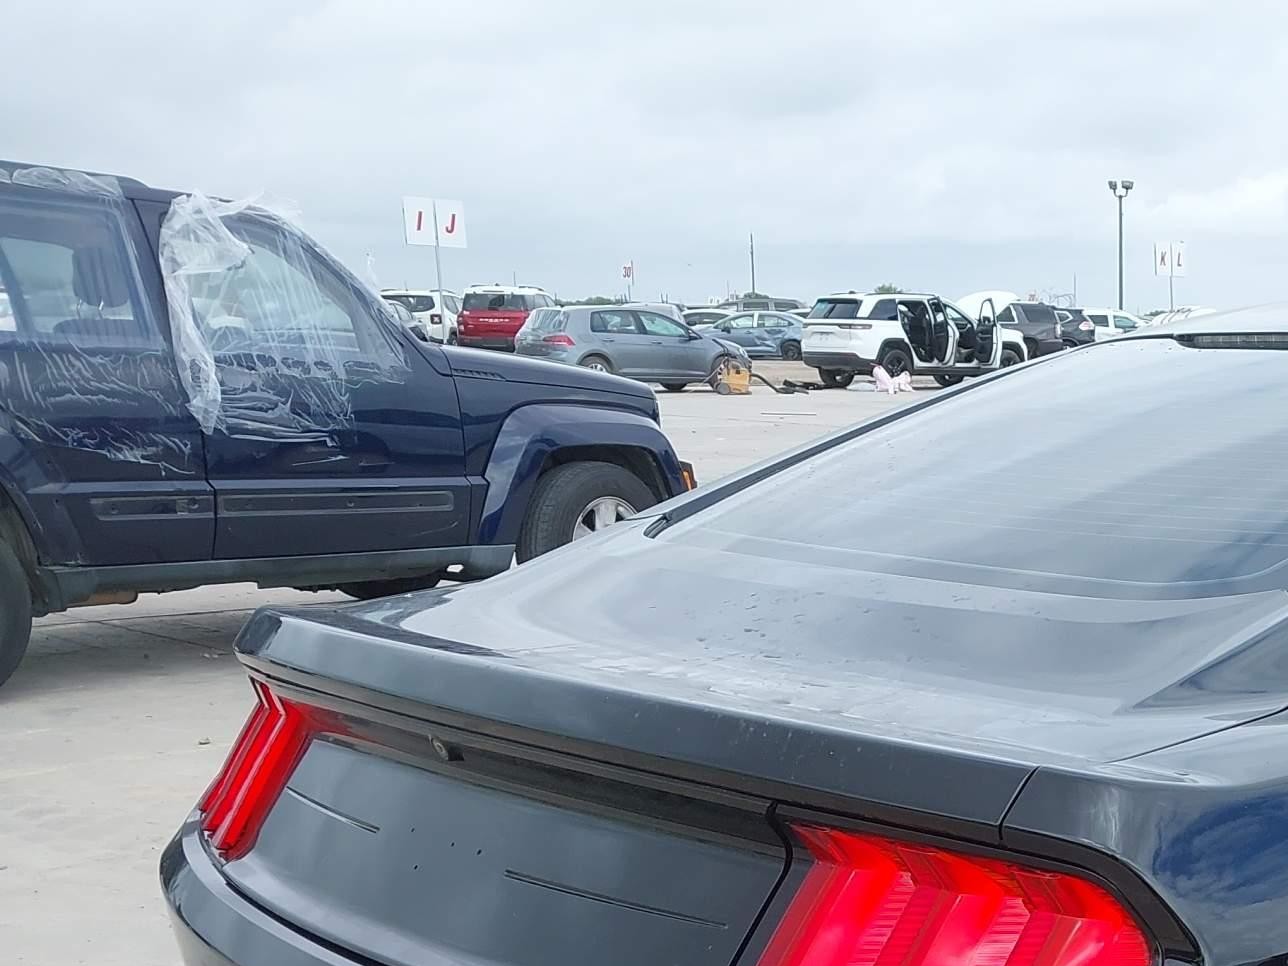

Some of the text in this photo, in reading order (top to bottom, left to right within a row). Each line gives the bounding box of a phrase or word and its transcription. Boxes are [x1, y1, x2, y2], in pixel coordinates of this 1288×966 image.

[416, 210, 423, 231] I
[445, 213, 456, 234] J
[1160, 250, 1167, 267] K
[1176, 251, 1183, 267] L
